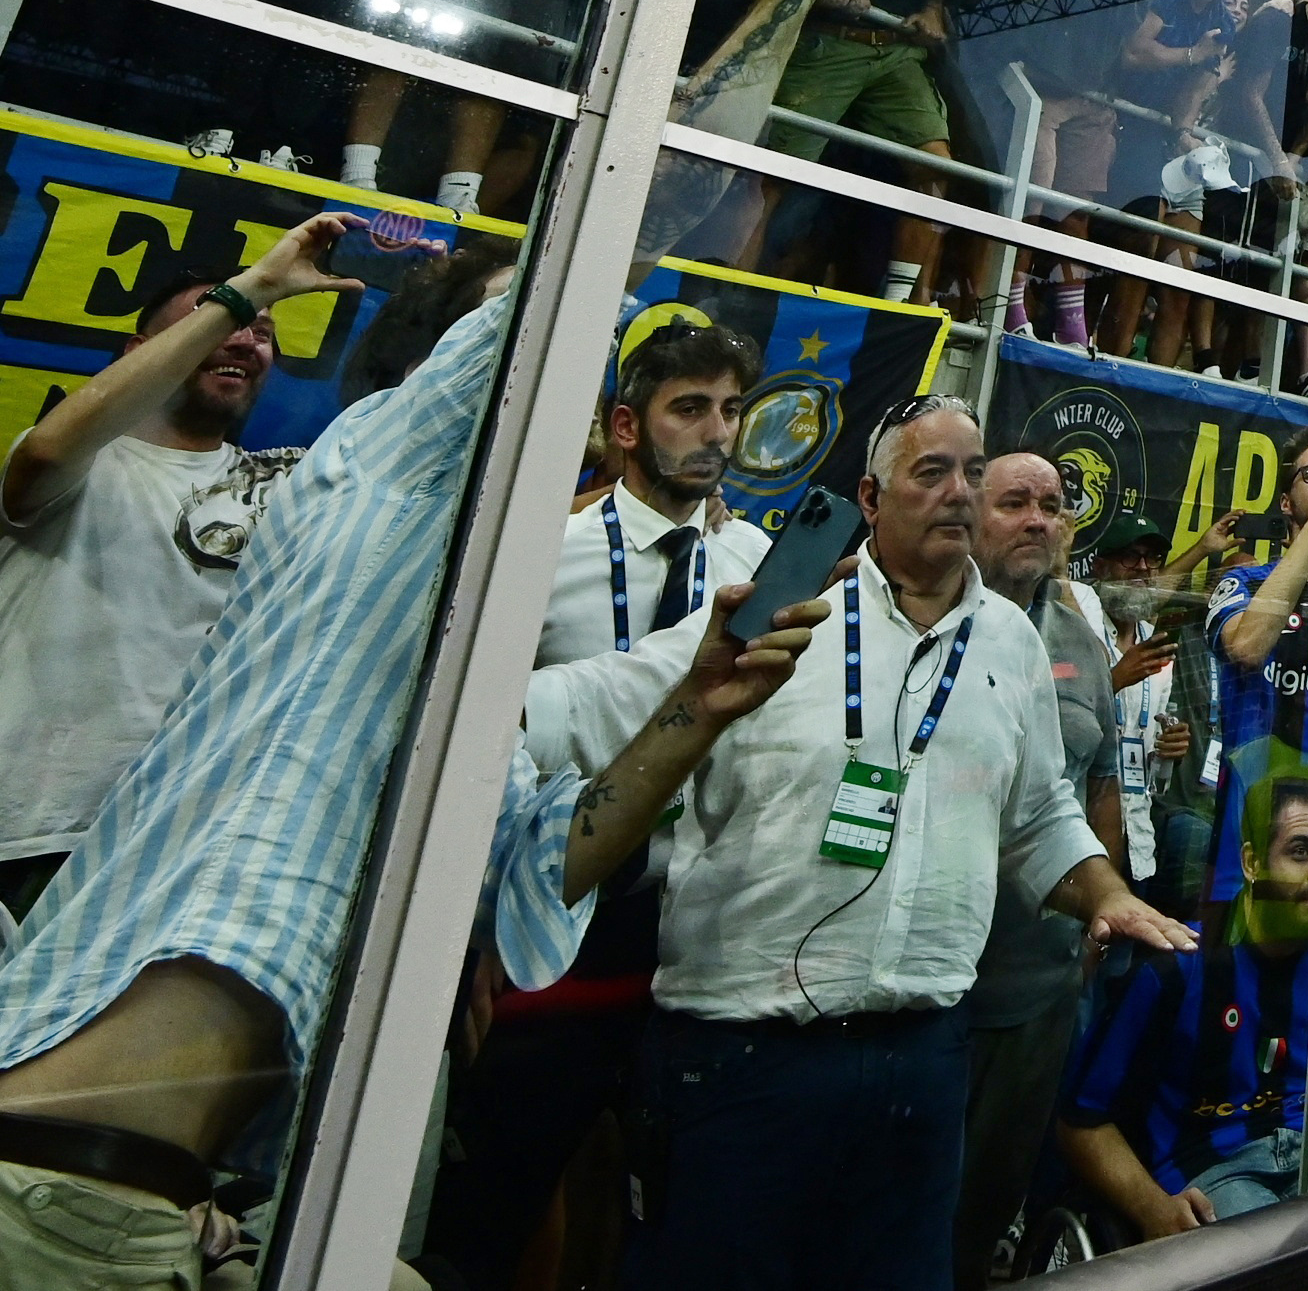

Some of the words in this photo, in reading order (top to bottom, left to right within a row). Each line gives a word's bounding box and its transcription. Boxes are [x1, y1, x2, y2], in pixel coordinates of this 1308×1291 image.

[791, 421, 819, 435] 1996
[1053, 403, 1093, 431] INTER
[1094, 406, 1126, 441] CLUB
[1122, 487, 1138, 508] 58
